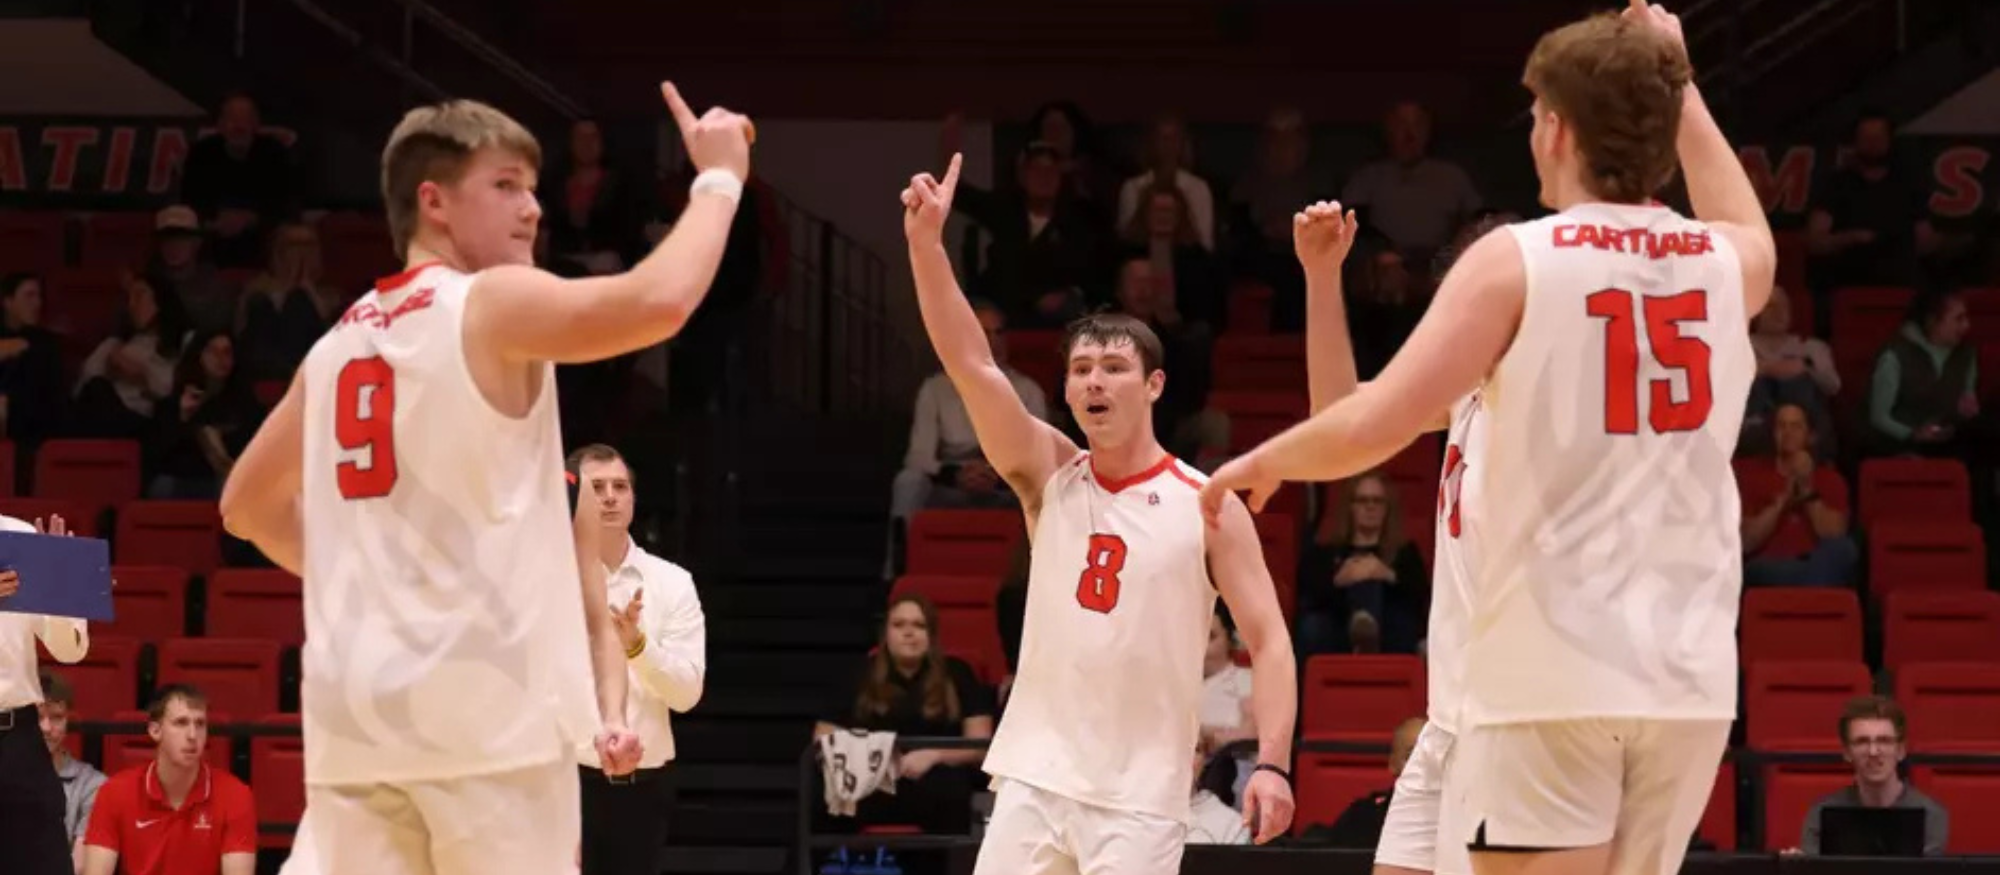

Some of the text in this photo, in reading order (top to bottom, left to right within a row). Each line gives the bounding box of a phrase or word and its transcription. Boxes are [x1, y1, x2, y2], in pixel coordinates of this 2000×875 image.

[1927, 144, 2000, 217] S
[1585, 287, 1714, 435] 15
[335, 353, 398, 501] 9
[1076, 532, 1128, 614] 8
